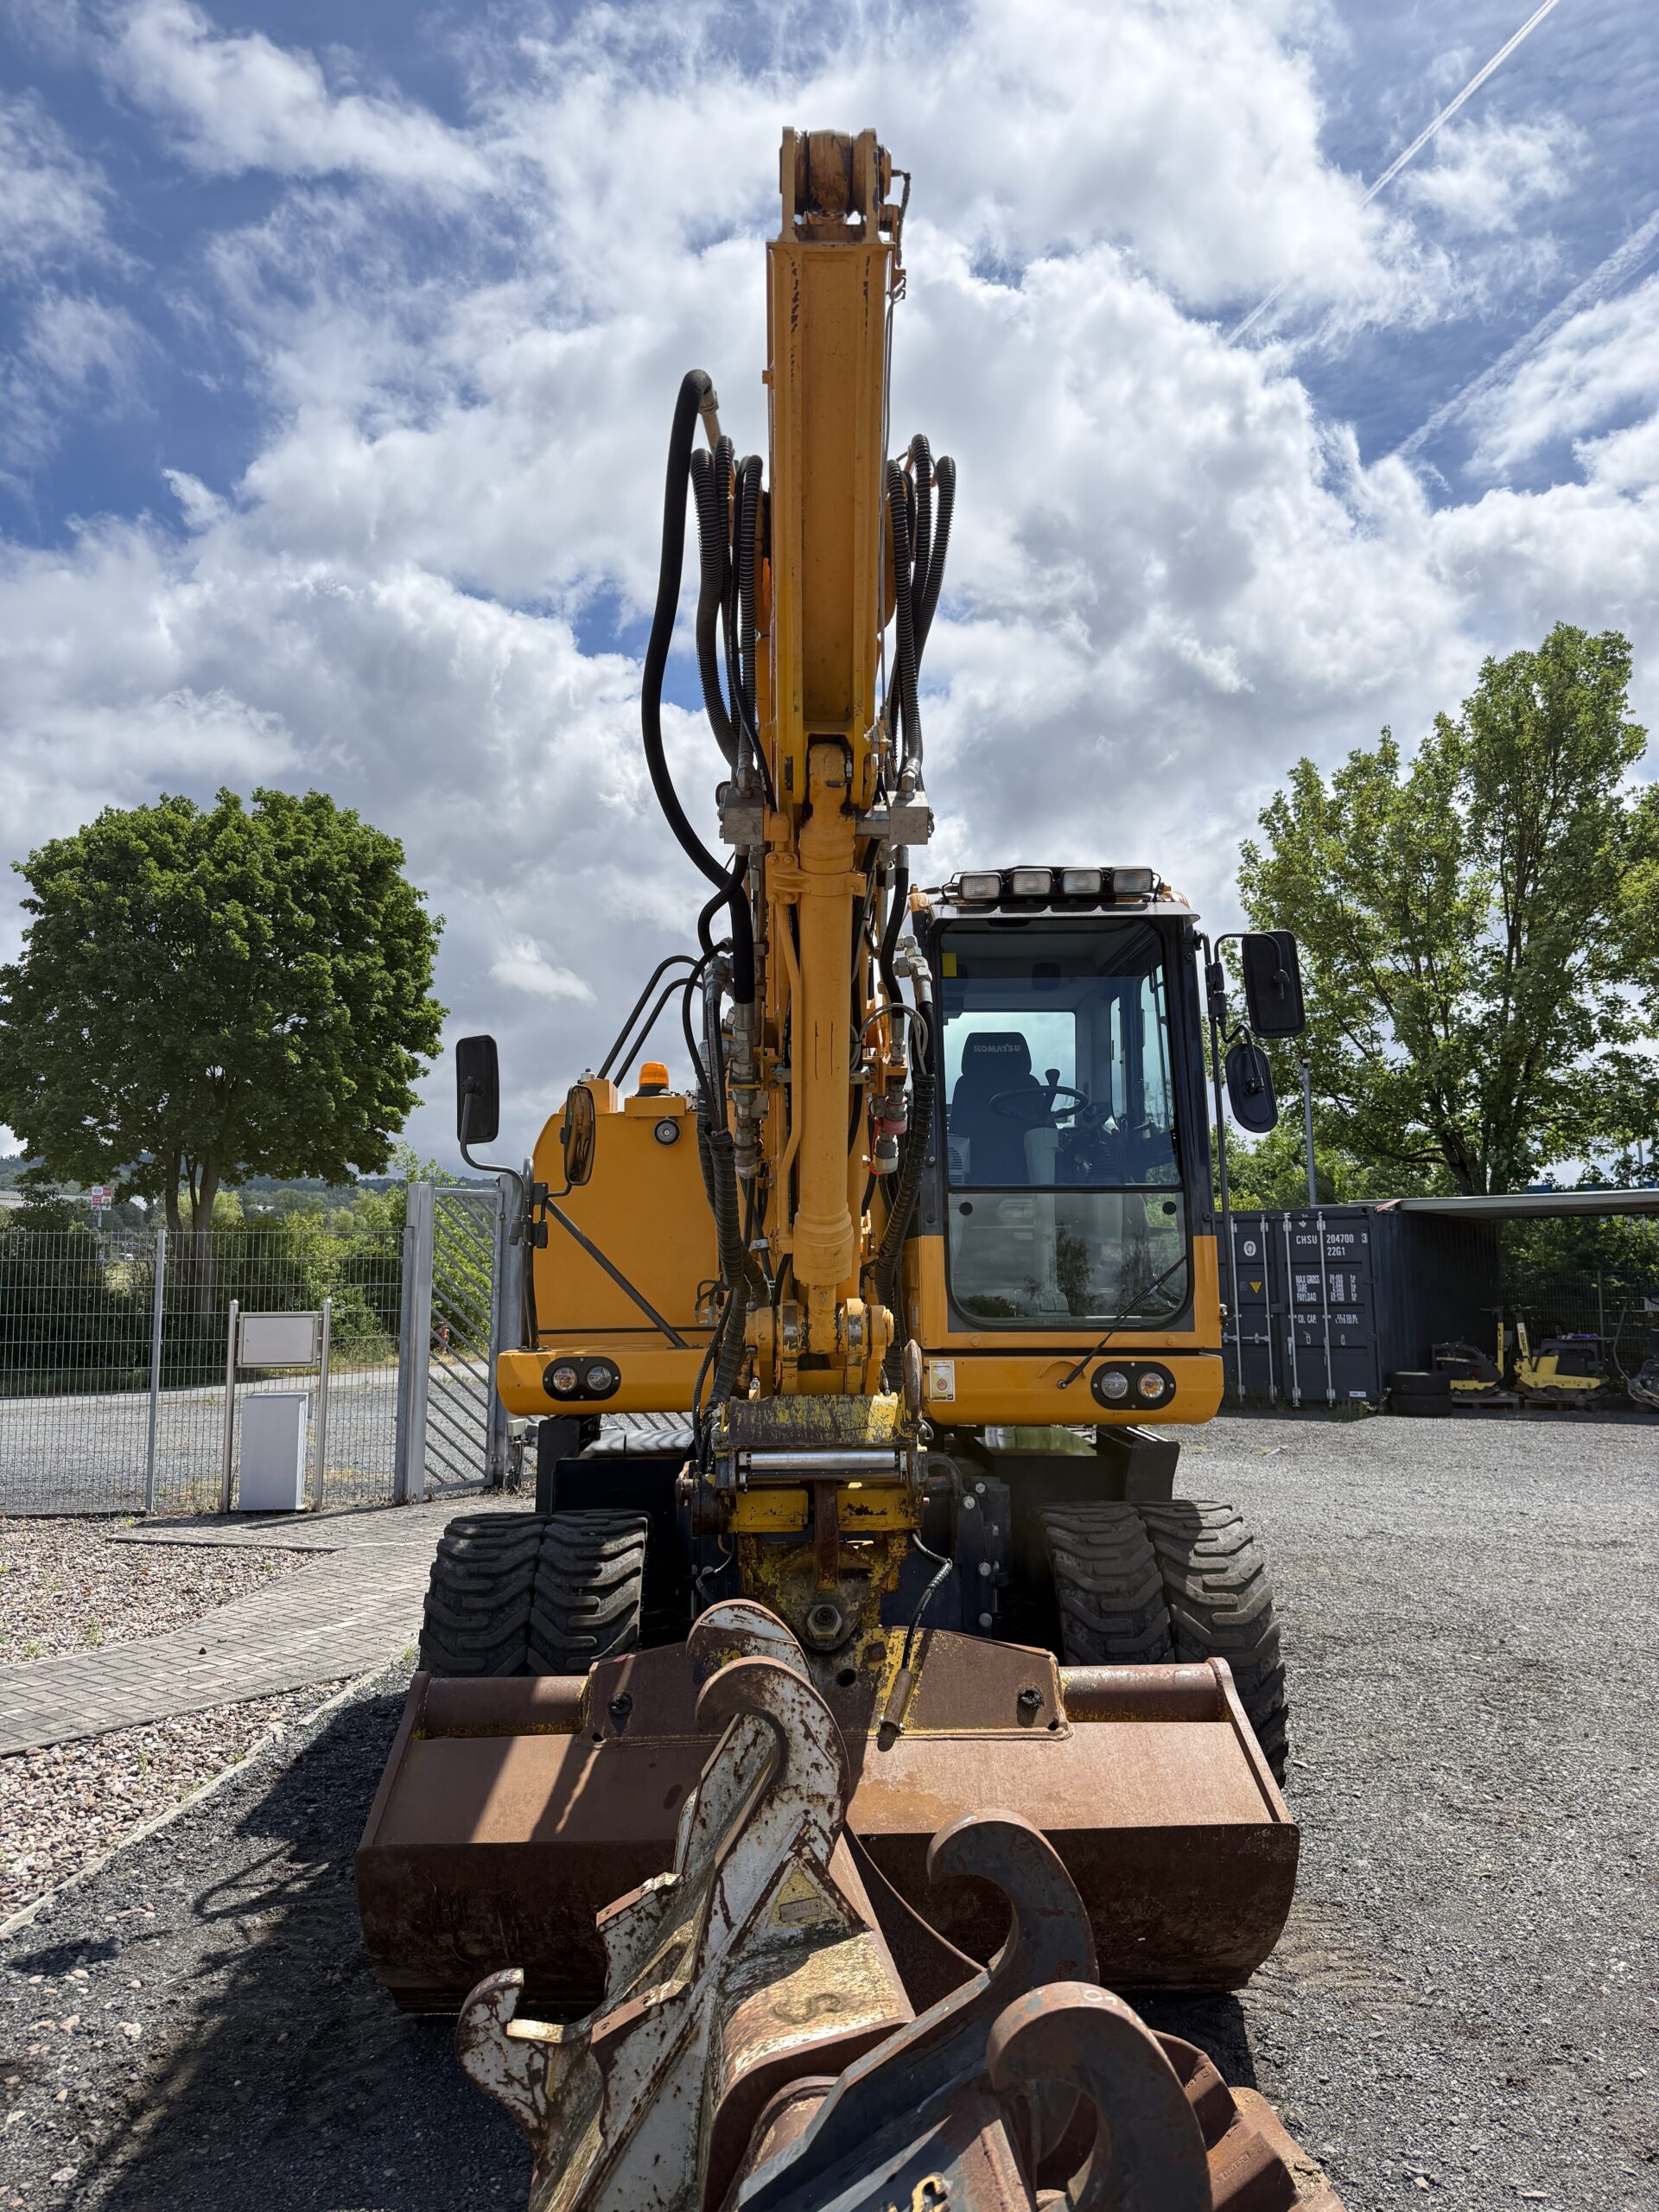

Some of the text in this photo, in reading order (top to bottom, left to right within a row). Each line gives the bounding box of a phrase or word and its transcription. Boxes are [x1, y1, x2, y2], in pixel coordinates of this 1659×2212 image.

[973, 1043, 1021, 1052] KOMATSU
[1295, 1233, 1368, 1245] CHSU 204700 3
[1326, 1246, 1345, 1256] 22G1
[1295, 1274, 1320, 1284] MAX GROSS
[1296, 1283, 1308, 1293] TARE
[1297, 1292, 1317, 1302] PAYLOAD
